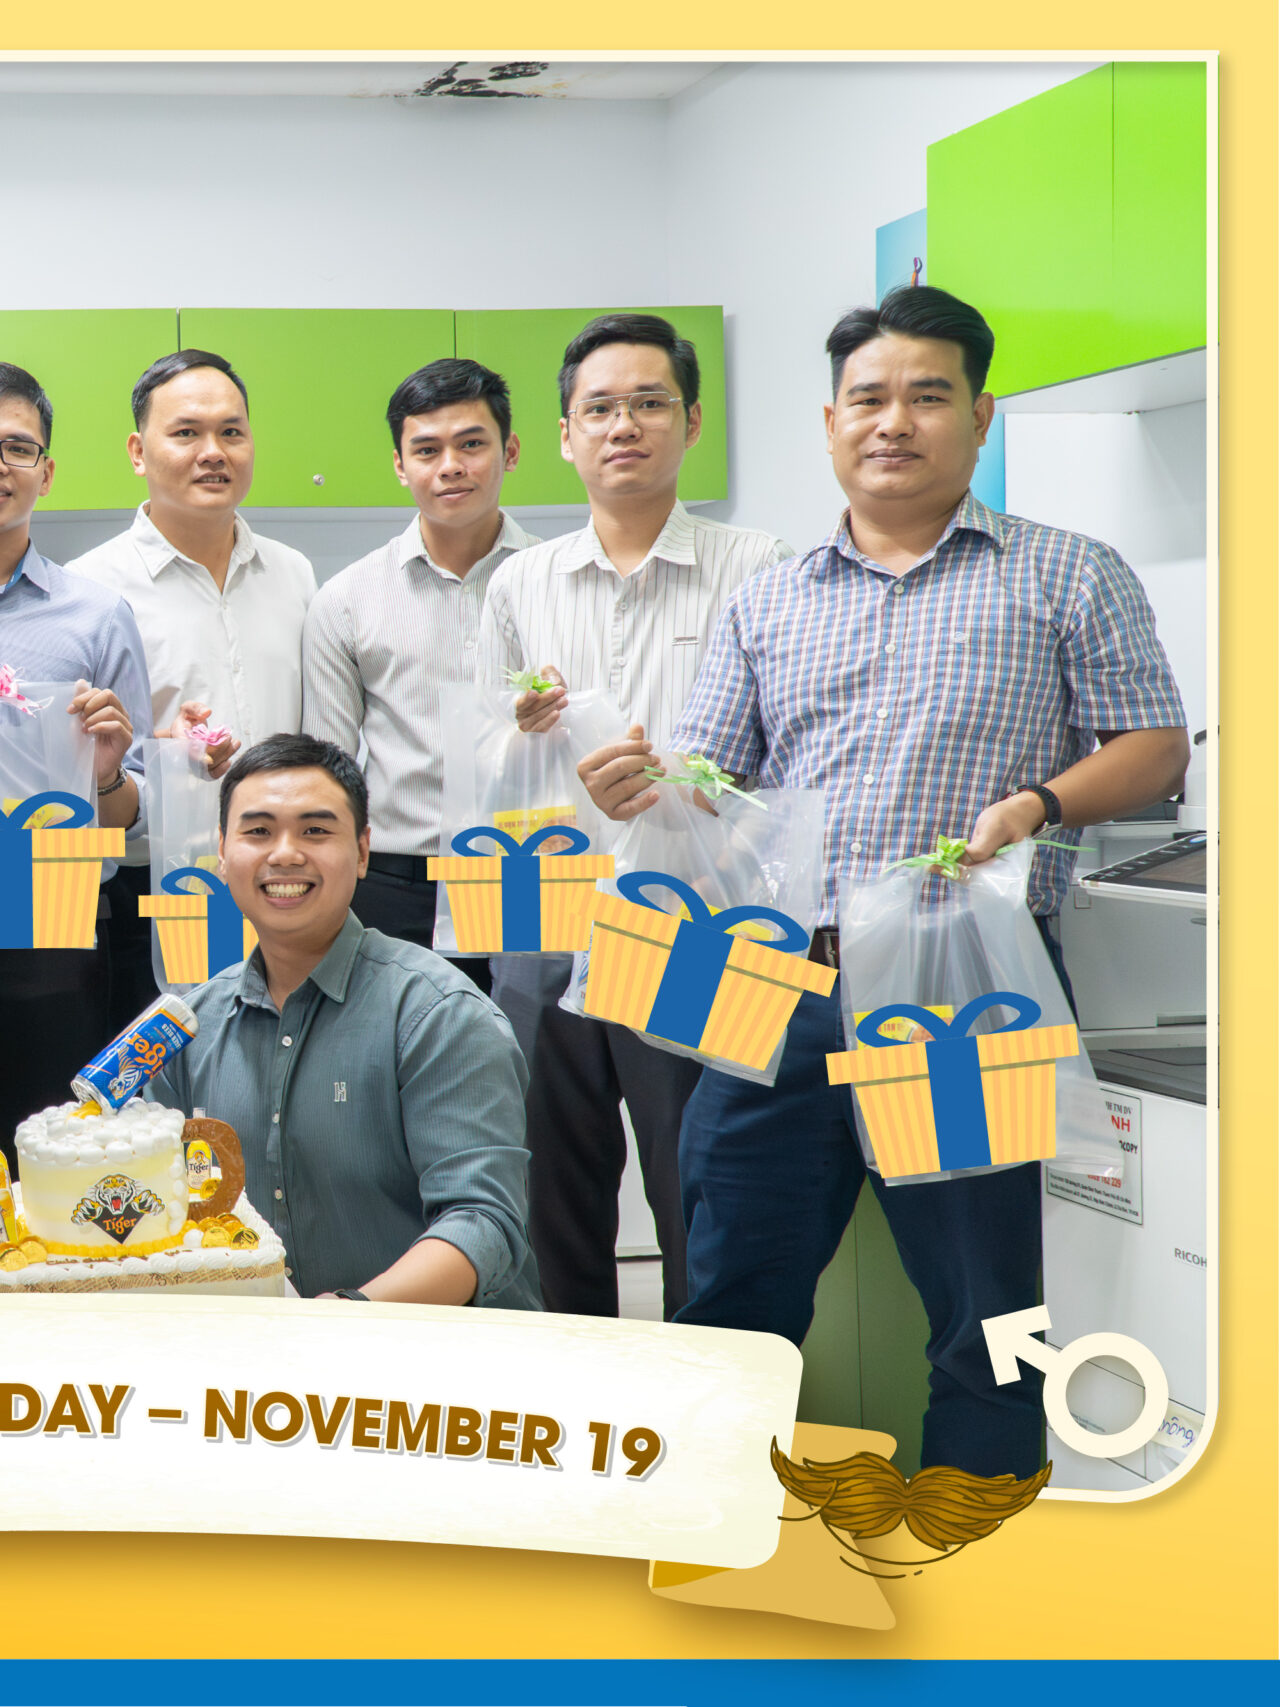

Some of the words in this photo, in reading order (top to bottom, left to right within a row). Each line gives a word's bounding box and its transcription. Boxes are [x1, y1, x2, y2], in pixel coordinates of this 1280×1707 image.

[189, 1162, 210, 1174] Tiger
[102, 1215, 138, 1235] Tiger
[1174, 1247, 1208, 1268] RICOH
